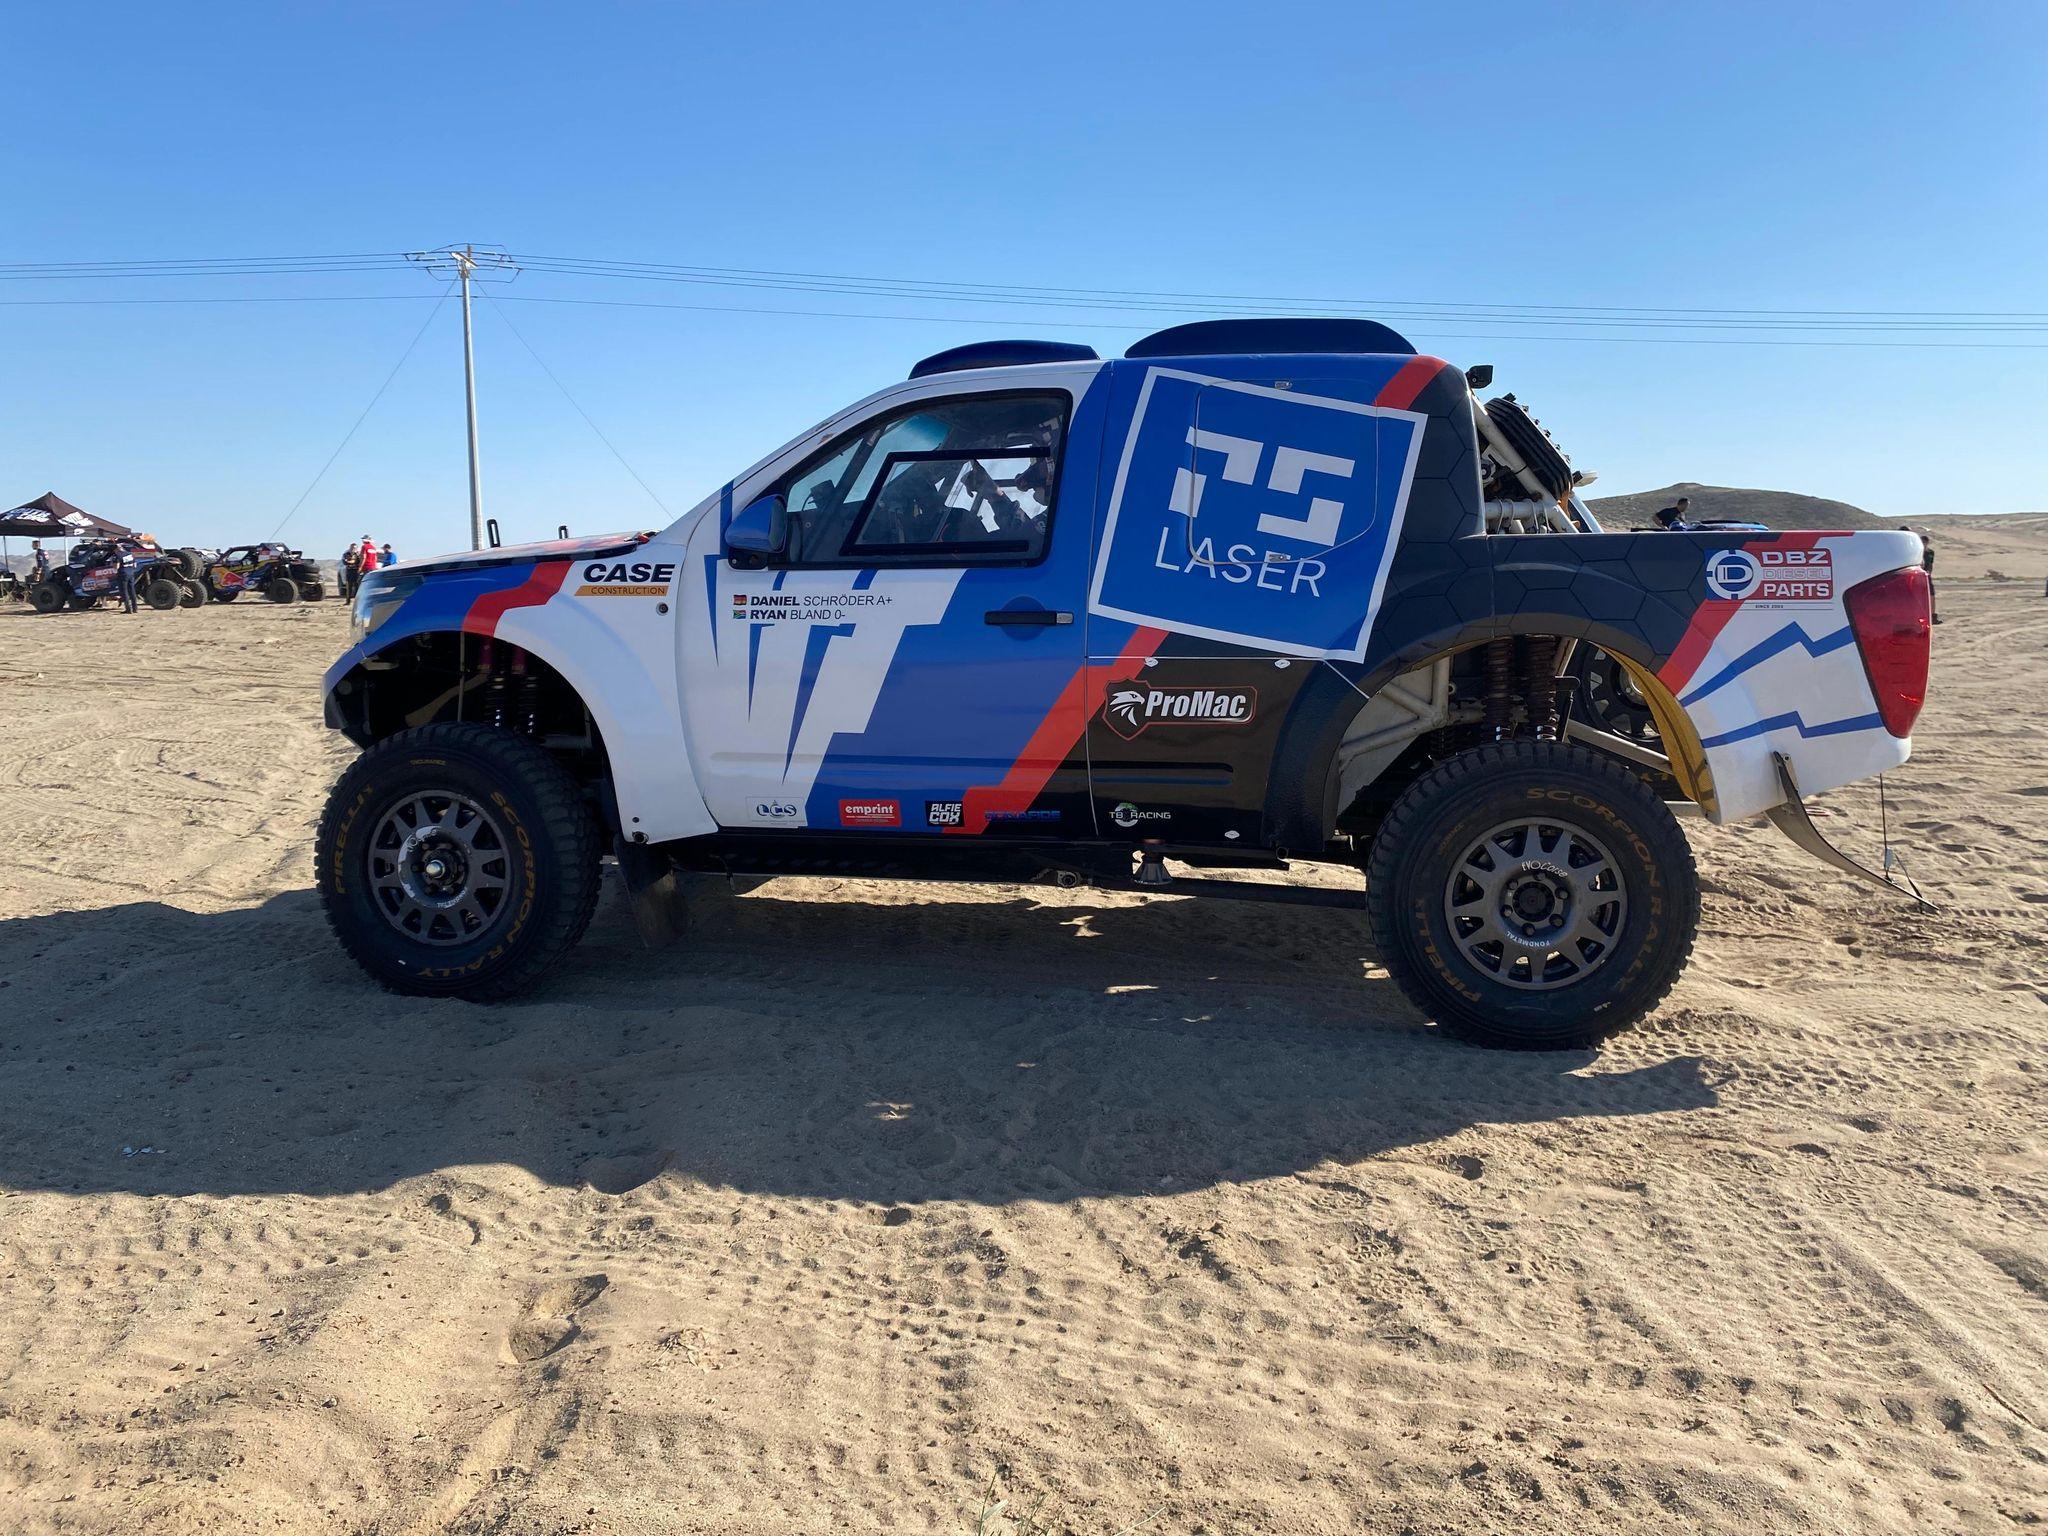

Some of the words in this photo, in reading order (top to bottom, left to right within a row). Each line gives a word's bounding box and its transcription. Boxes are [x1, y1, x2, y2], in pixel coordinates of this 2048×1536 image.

[1155, 526, 1327, 598] LASER
[1761, 551, 1829, 565] DBZ
[583, 563, 676, 583] CASE
[1762, 568, 1830, 580] DIESEL
[590, 586, 666, 596] CONSTRUCTION
[1763, 583, 1830, 597] PARTS
[750, 596, 800, 607] DANIEL
[803, 594, 875, 607] SCHRÖDER
[876, 595, 893, 606] A+
[750, 609, 787, 620] RYAN
[790, 609, 831, 620] BLAND
[1144, 690, 1247, 718] ProMac
[845, 803, 894, 815] emprint
[931, 803, 962, 812] ALFIE
[929, 812, 960, 822] COX
[1130, 811, 1172, 819] RACING
[1526, 787, 1661, 888] SCORPION
[490, 790, 536, 943] SCORPION
